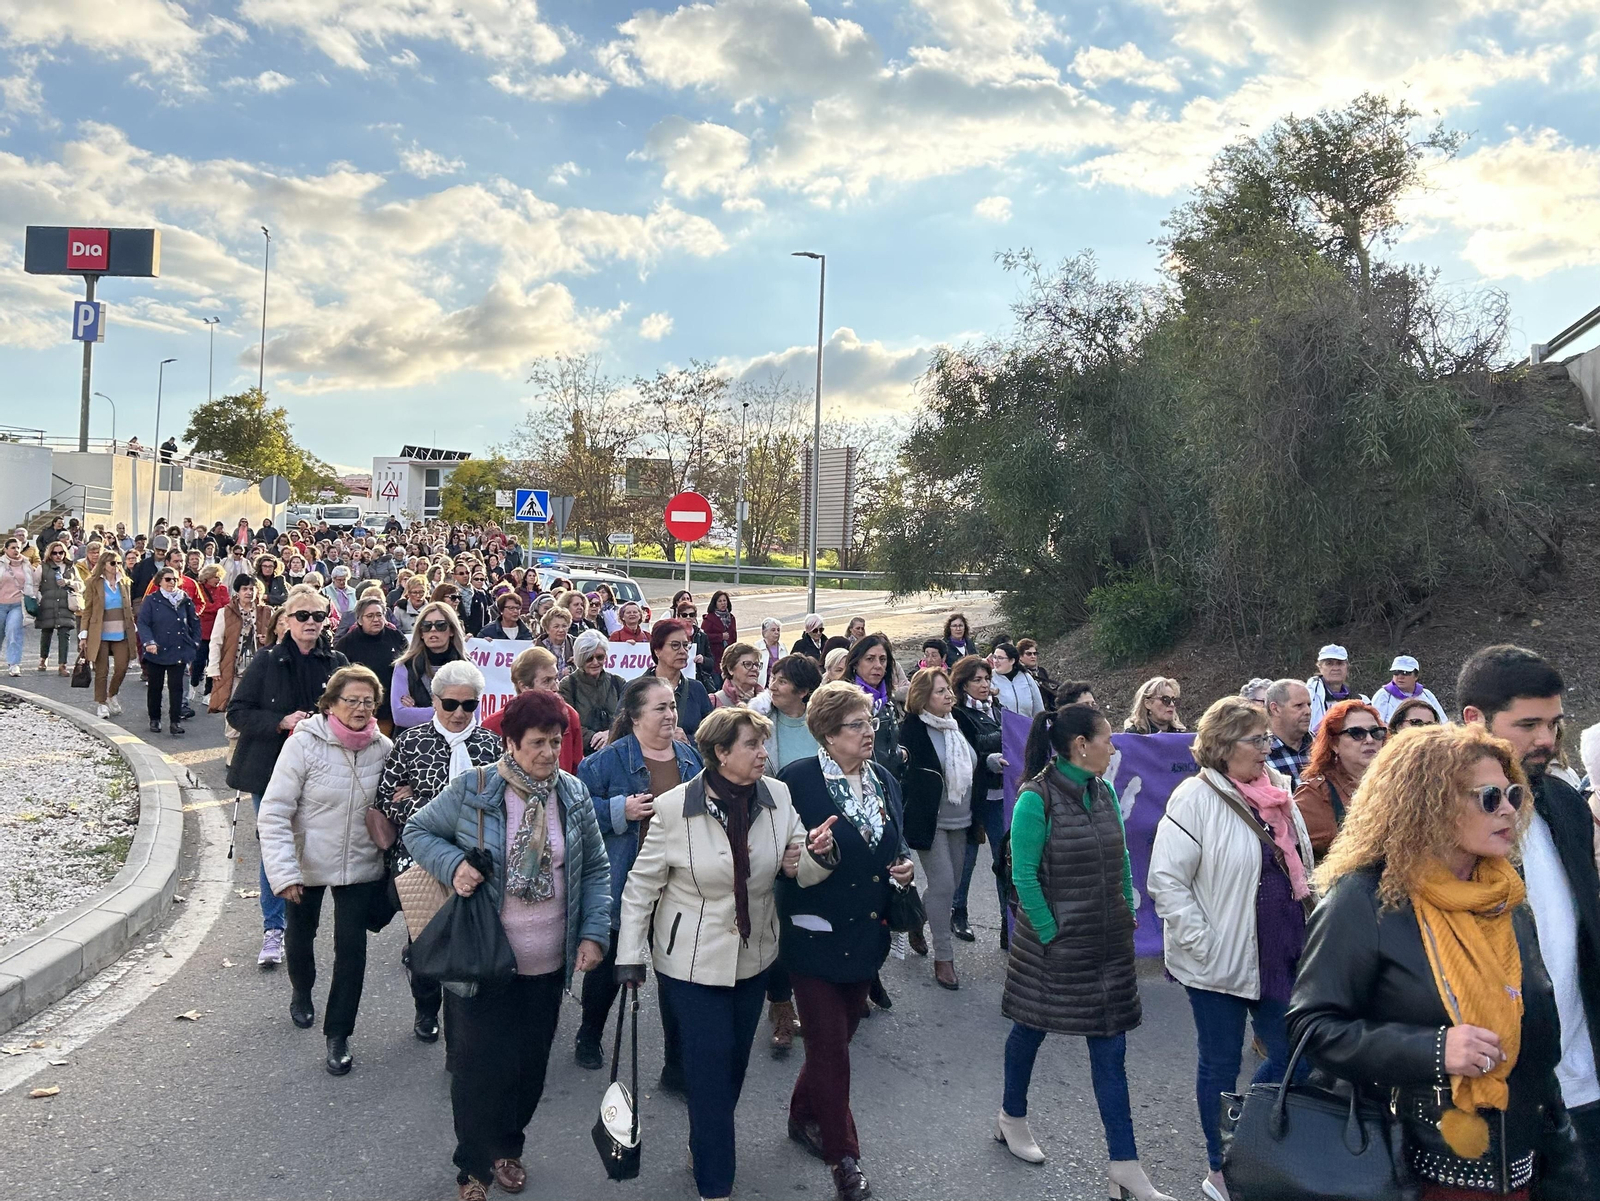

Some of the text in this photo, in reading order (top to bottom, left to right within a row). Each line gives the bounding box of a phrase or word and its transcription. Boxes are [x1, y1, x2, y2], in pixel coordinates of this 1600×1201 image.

[77, 304, 95, 337] P
[494, 652, 515, 668] DE
[620, 654, 654, 669] AZUC
